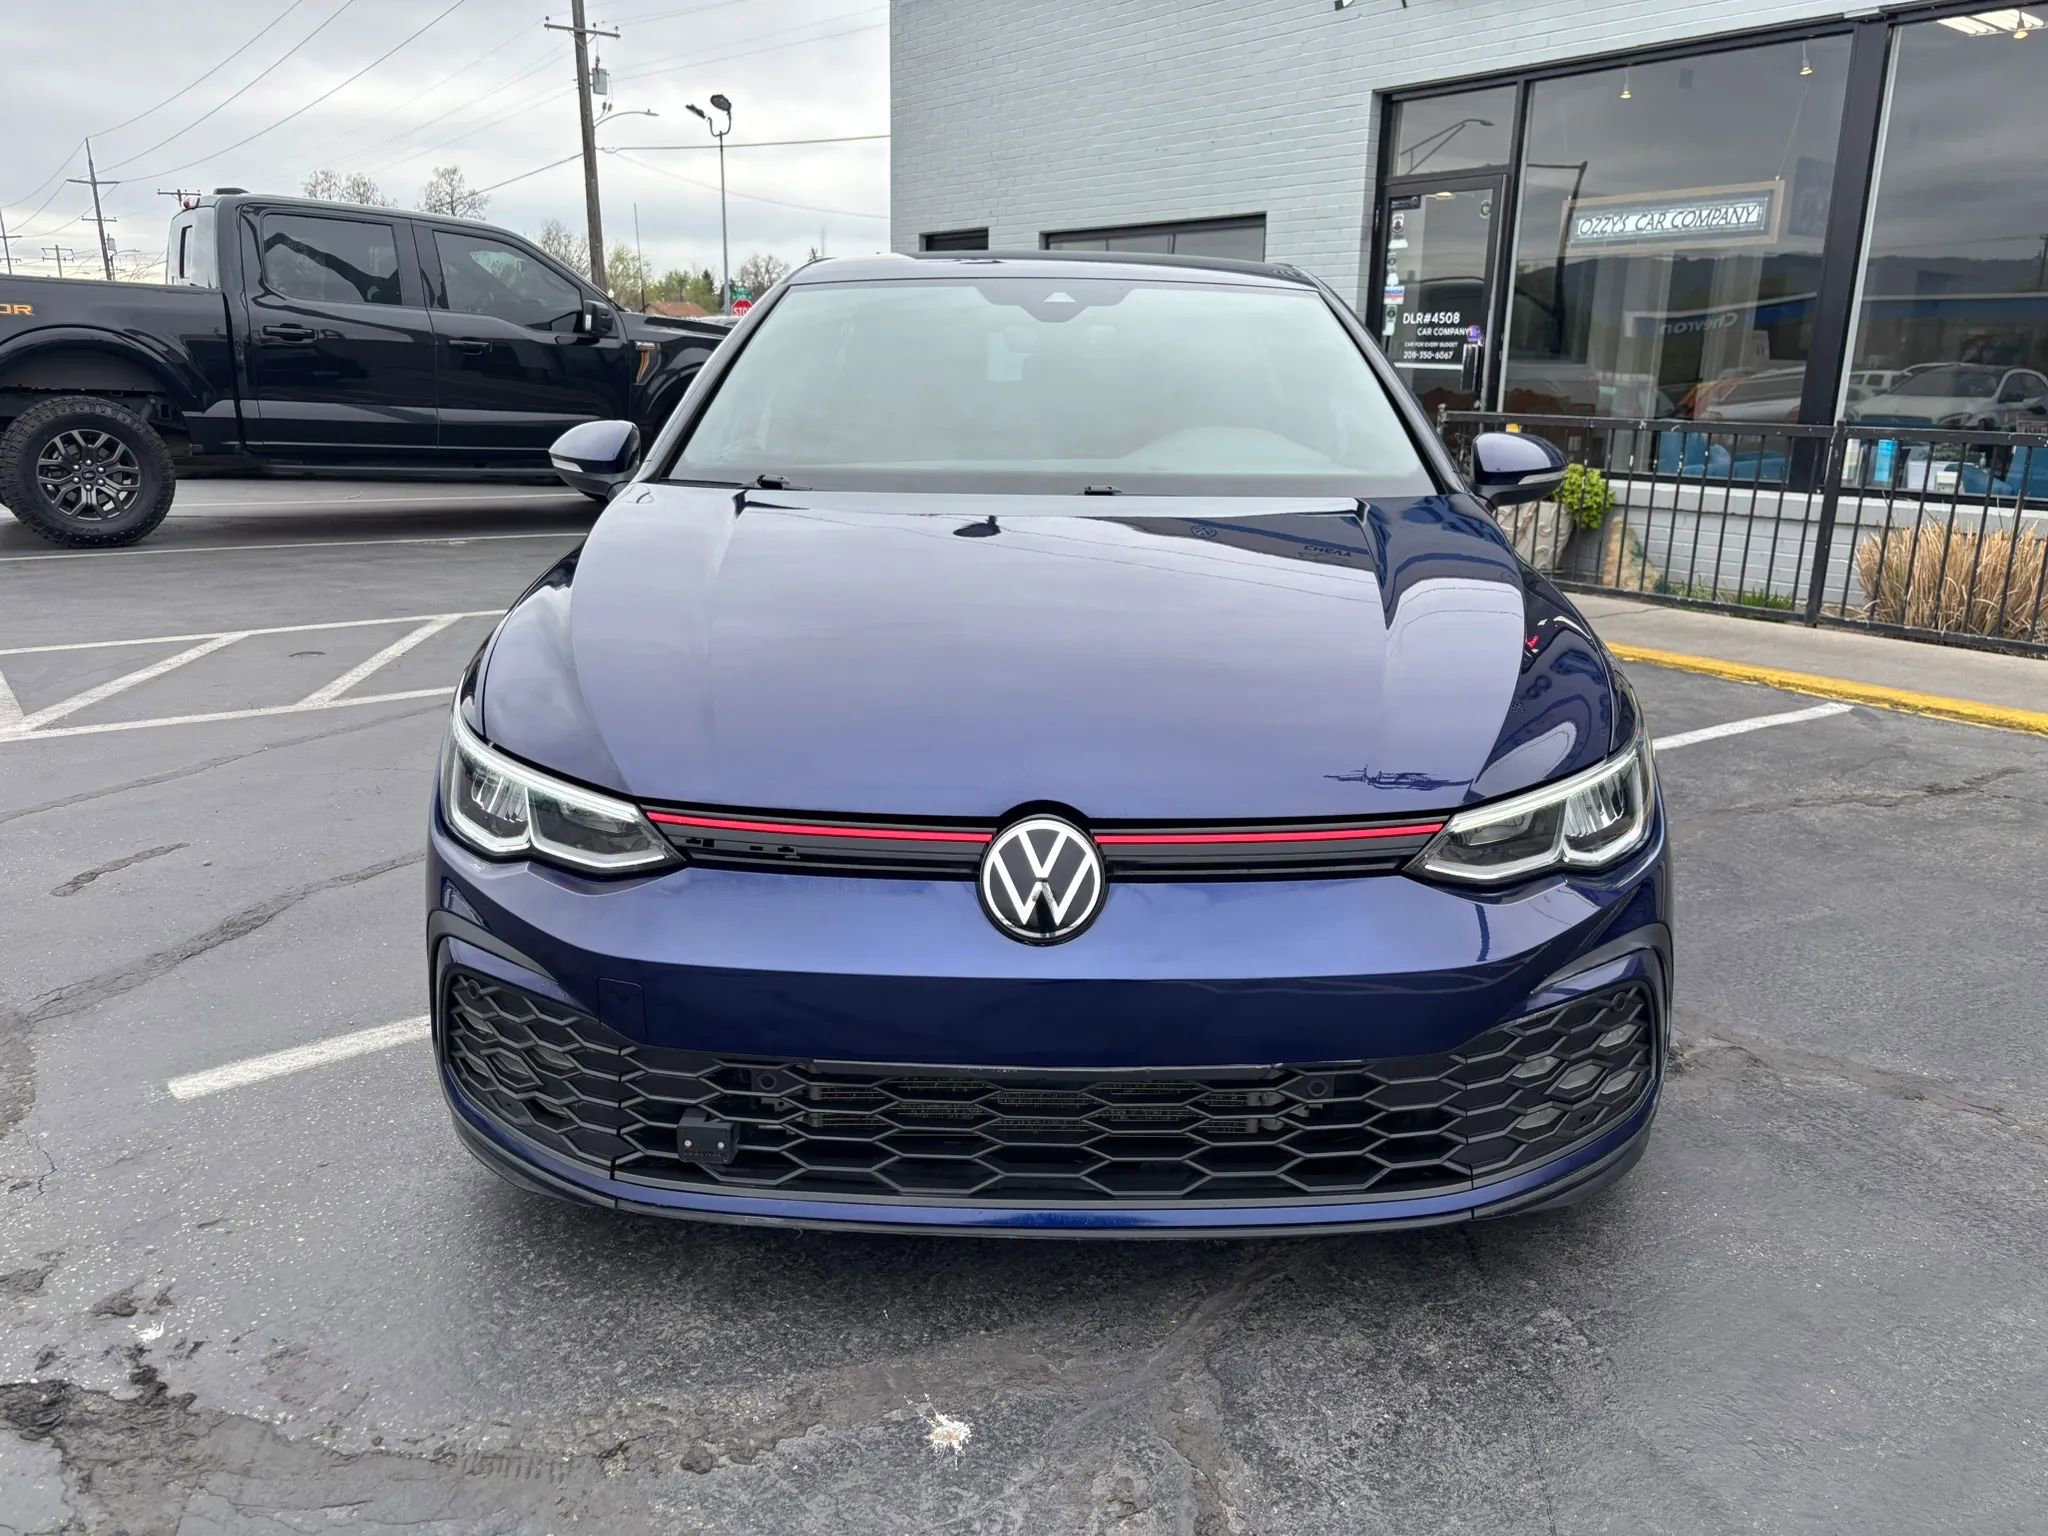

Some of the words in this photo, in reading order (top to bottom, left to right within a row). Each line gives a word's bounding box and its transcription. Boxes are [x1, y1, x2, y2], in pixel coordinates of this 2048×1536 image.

[1579, 215, 1630, 235] OZZY'S
[1635, 212, 1667, 231] CAR
[1670, 205, 1758, 229] COMPANY
[733, 307, 749, 317] STO
[1403, 312, 1460, 324] DLR#4508
[1416, 327, 1432, 336] CAR
[1433, 326, 1469, 336] COMPANY
[1403, 350, 1453, 360] 208-350-6067
[988, 822, 1098, 930] VW
